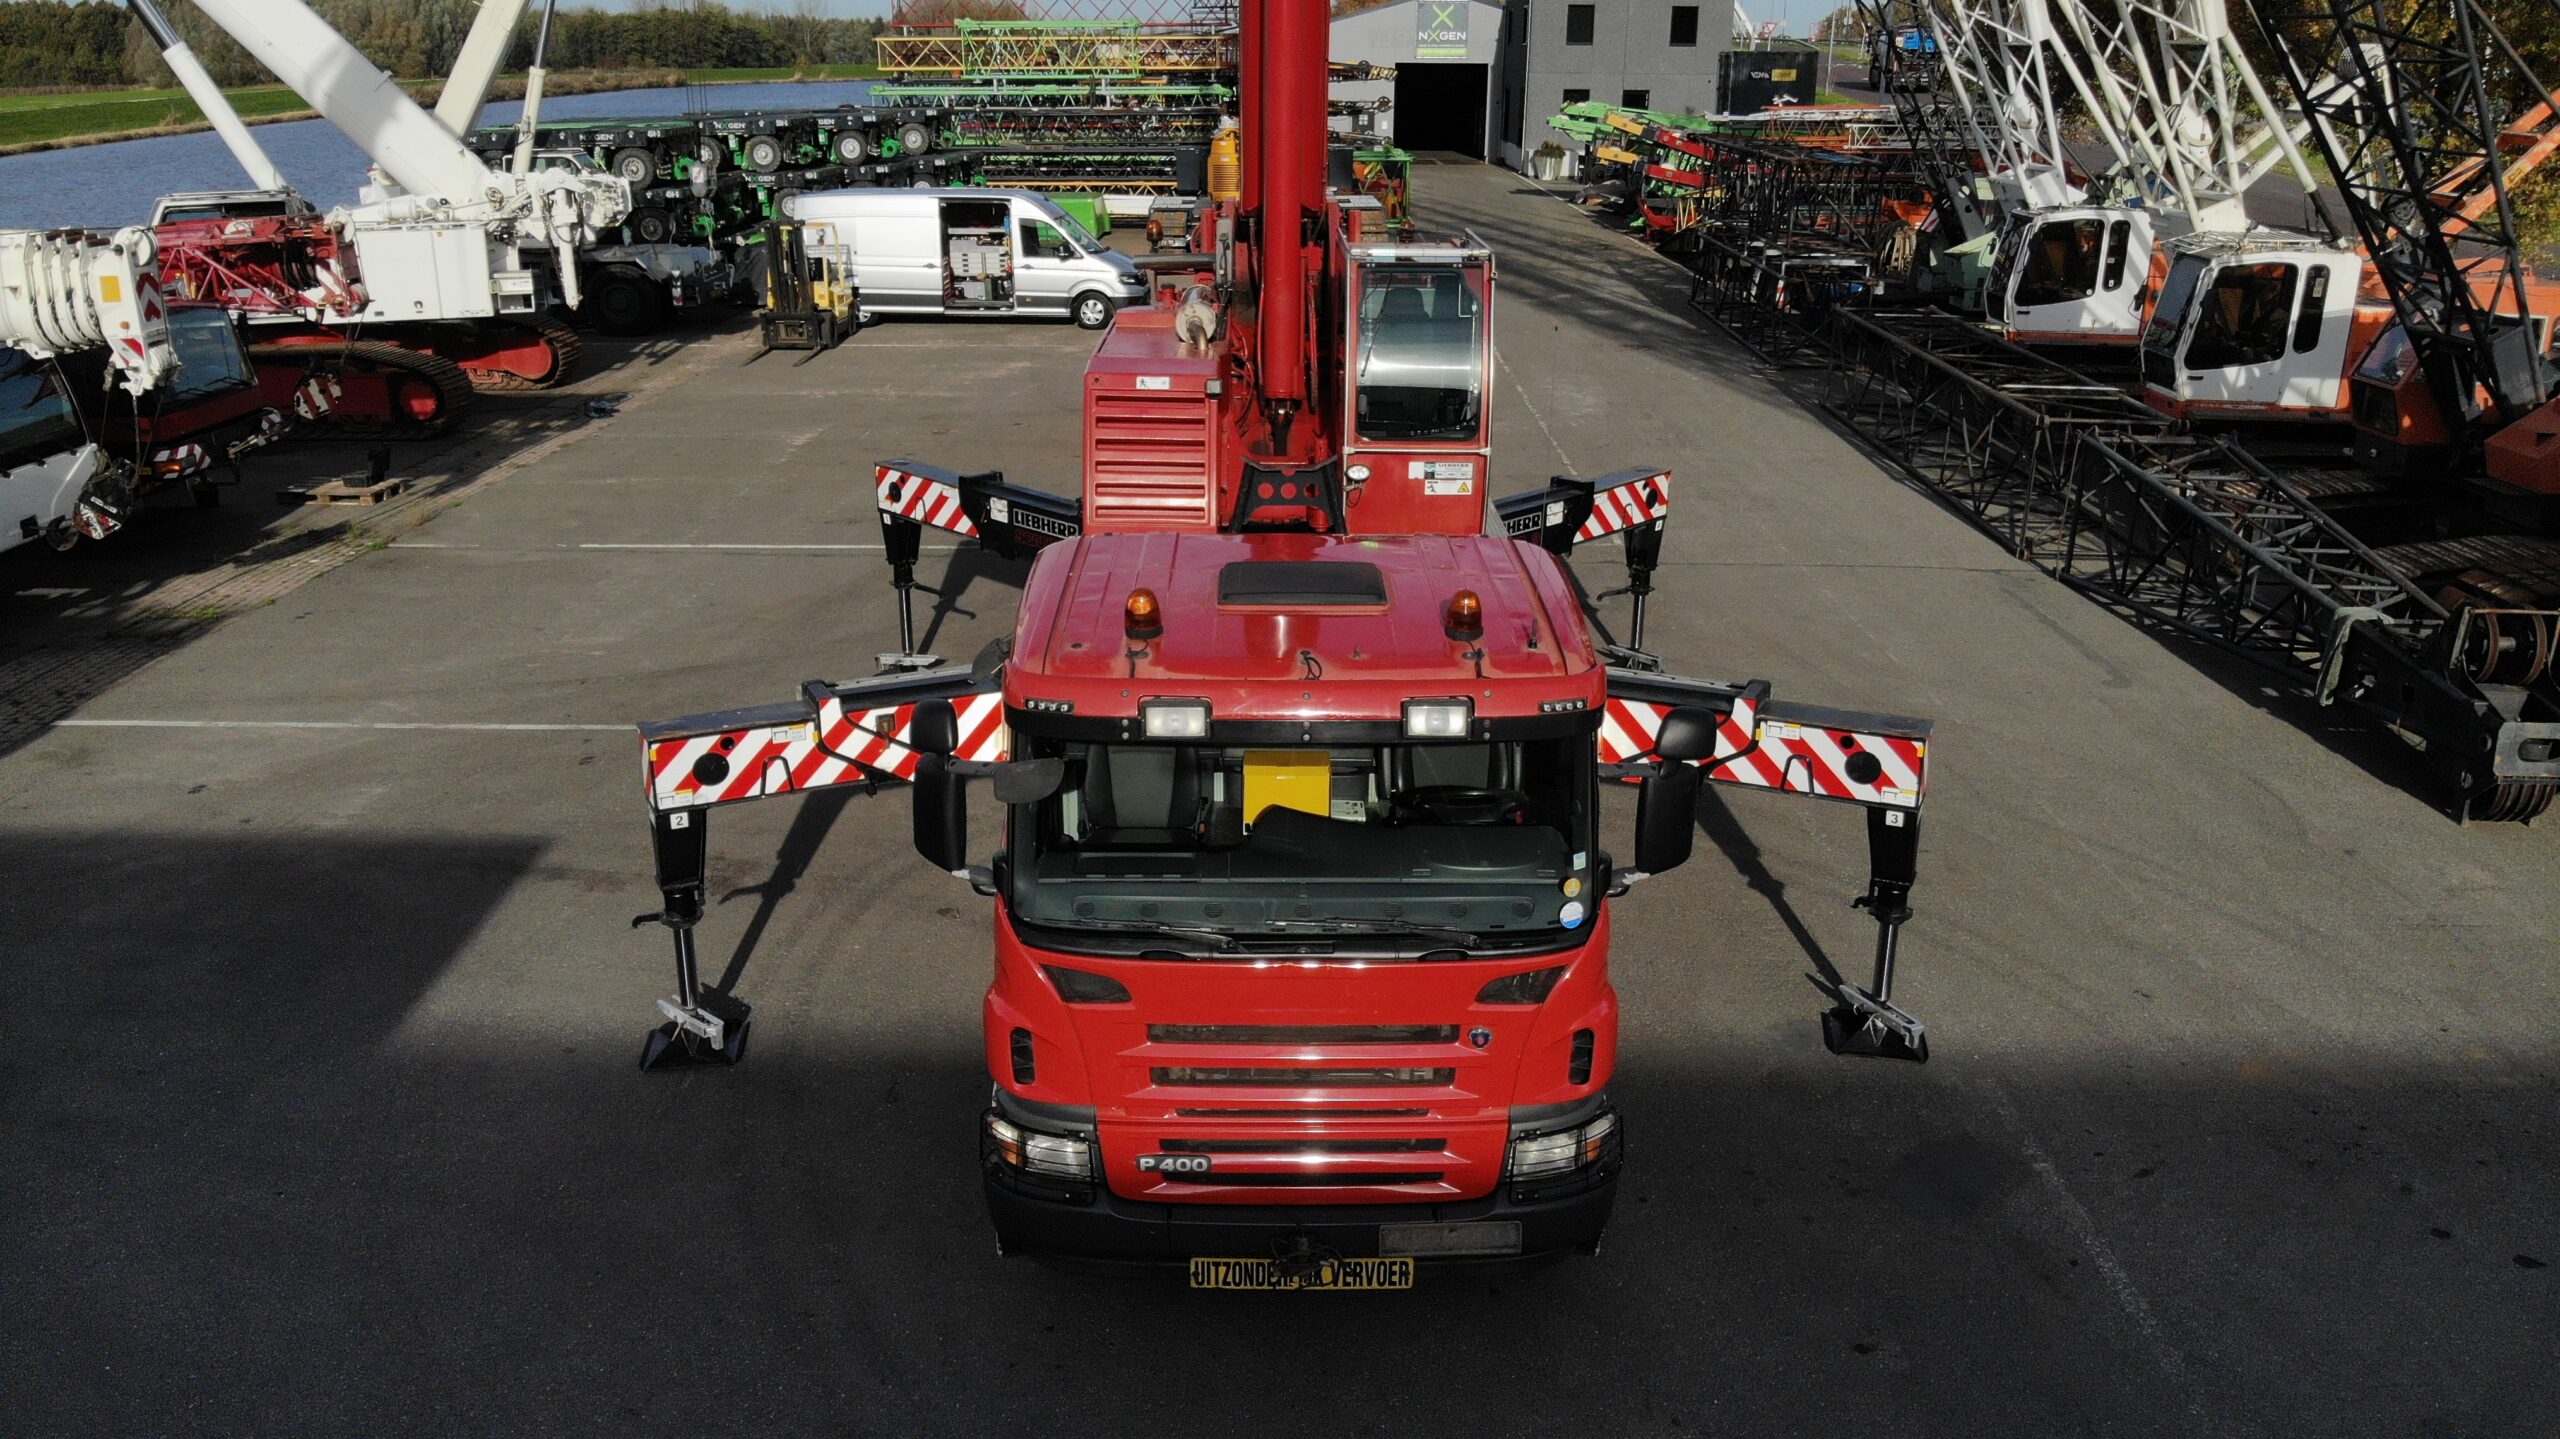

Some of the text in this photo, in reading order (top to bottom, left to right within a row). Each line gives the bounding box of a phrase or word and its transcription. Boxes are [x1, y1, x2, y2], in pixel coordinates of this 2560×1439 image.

[1418, 29, 1466, 42] NXGEN
[717, 120, 745, 129] NXGEN
[579, 133, 614, 142] NXGEN
[745, 174, 776, 182] NXGEN
[1013, 508, 1078, 538] LIEBHERR
[1505, 513, 1542, 536] HERR
[675, 815, 684, 826] 2
[1890, 813, 1898, 824] 3
[1140, 1158, 1208, 1172] P 400
[1330, 1260, 1410, 1287] VERVOER
